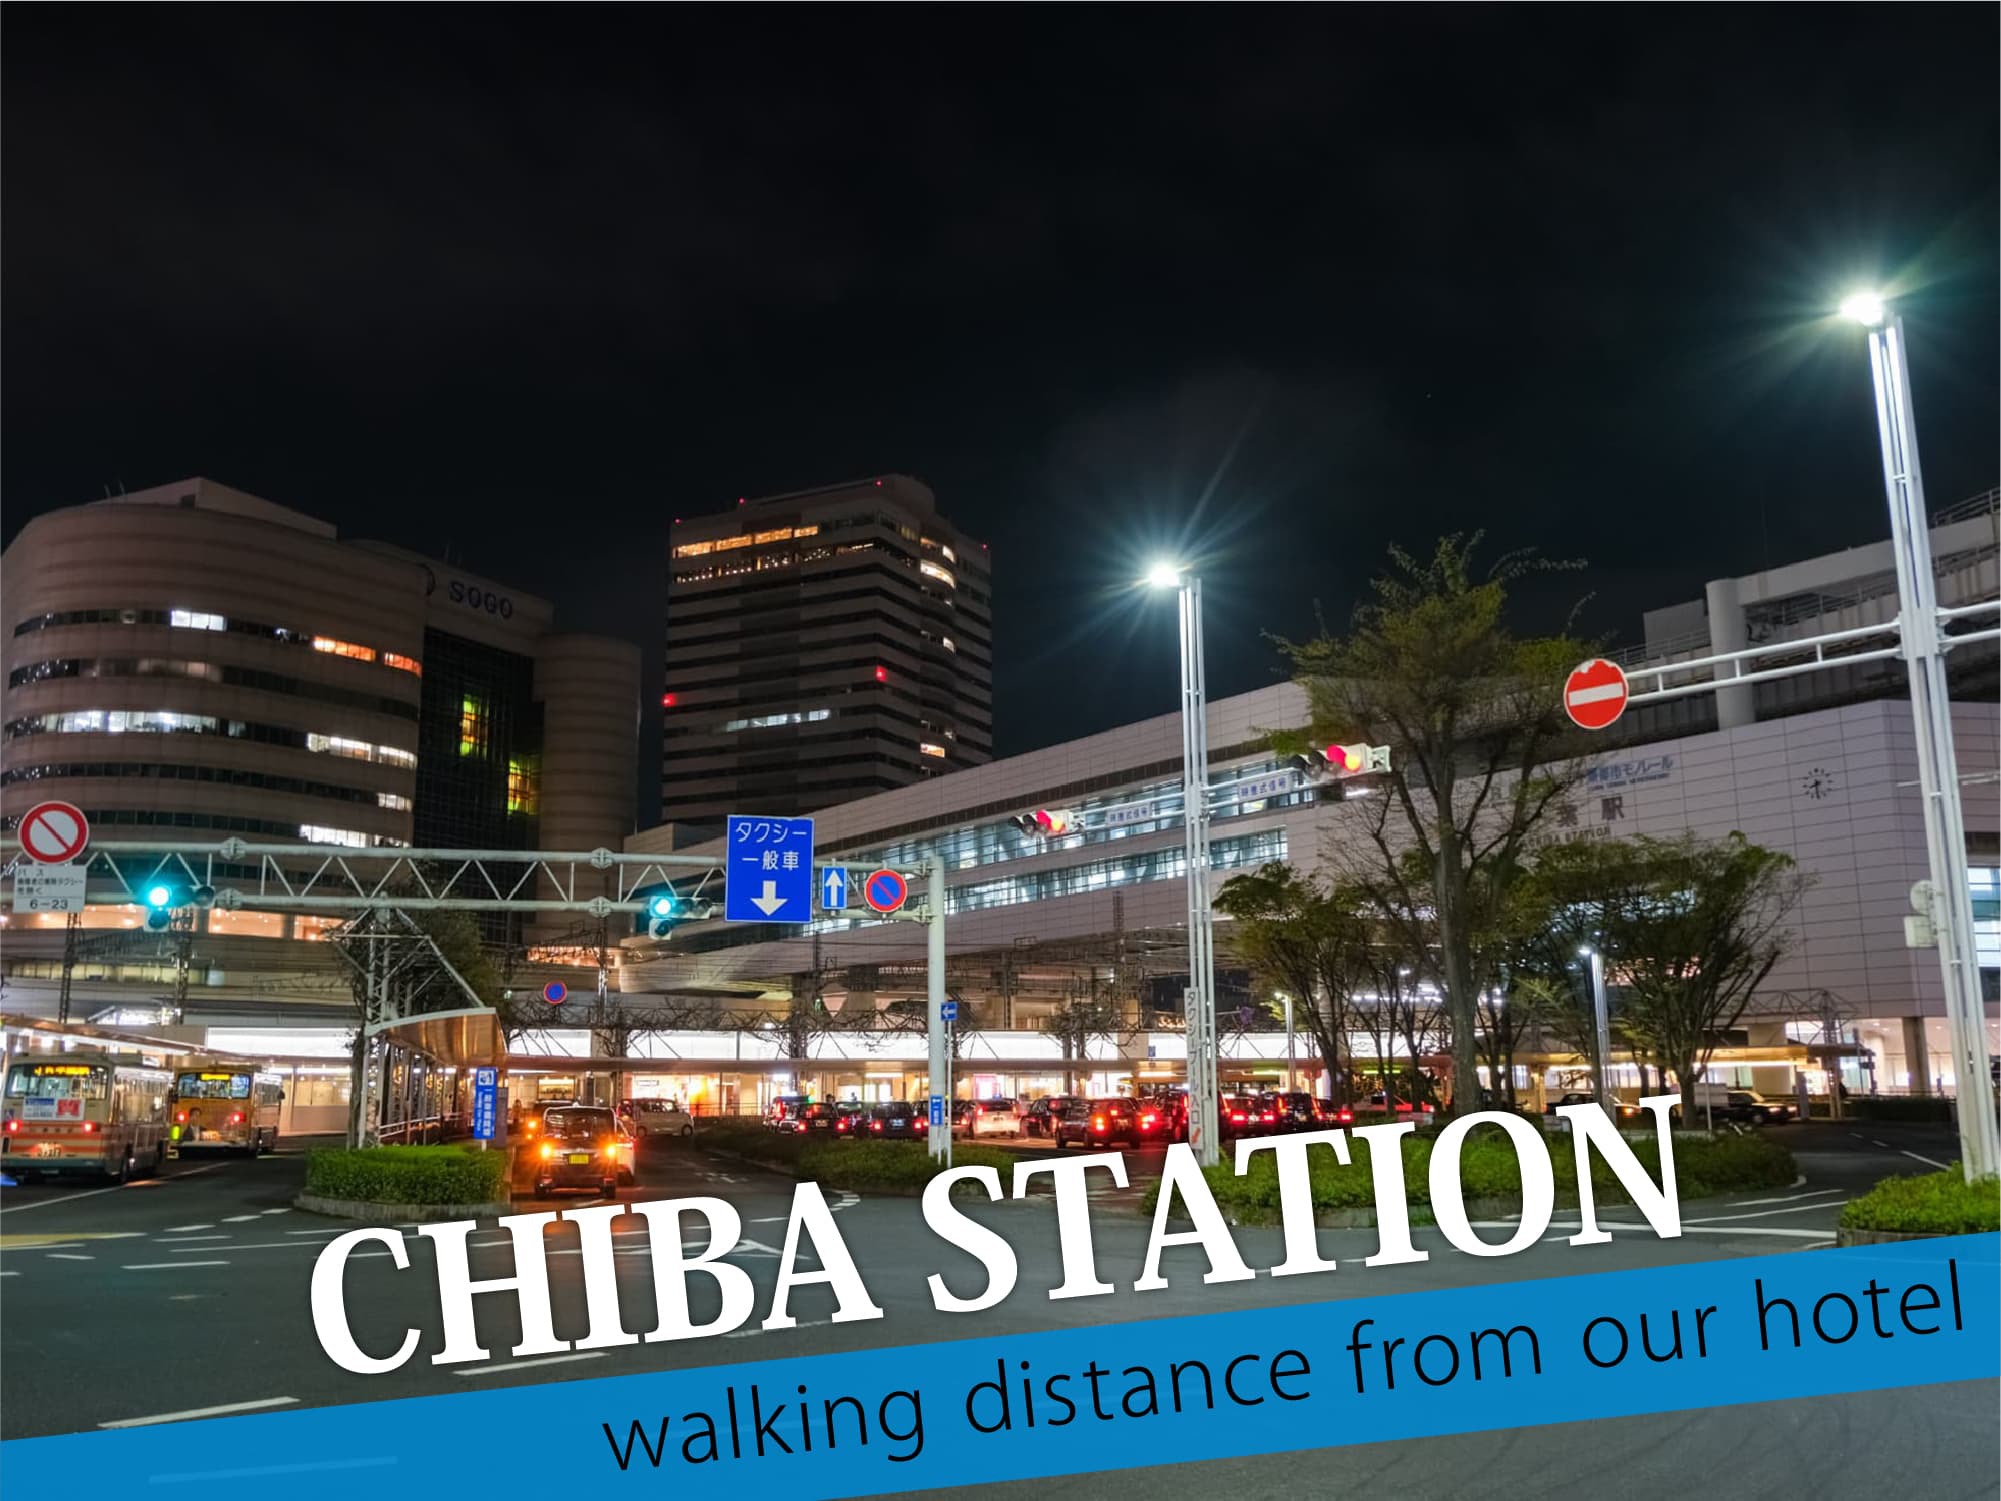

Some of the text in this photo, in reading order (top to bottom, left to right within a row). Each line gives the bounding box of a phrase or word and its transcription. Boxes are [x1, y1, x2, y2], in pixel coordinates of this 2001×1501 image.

[448, 580, 513, 620] SOGO
[736, 823, 807, 843] タクシー
[742, 850, 800, 871] 一般車
